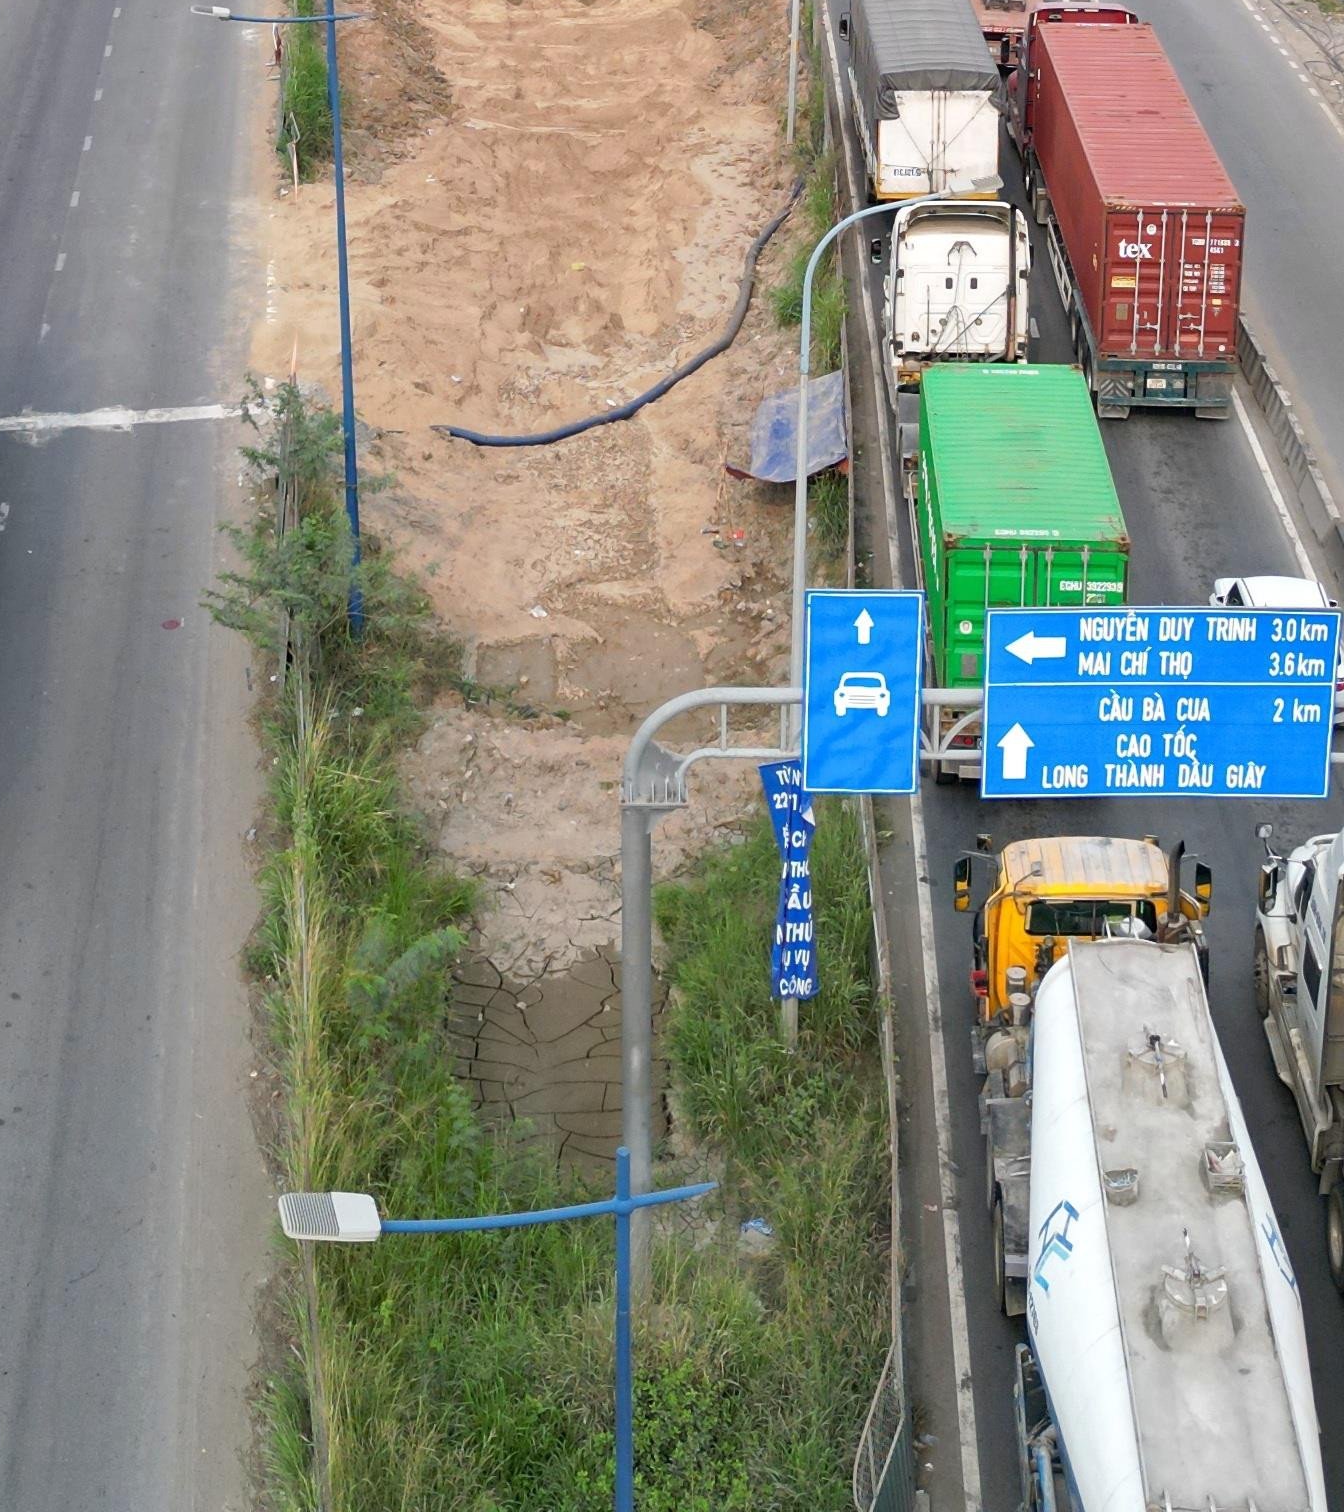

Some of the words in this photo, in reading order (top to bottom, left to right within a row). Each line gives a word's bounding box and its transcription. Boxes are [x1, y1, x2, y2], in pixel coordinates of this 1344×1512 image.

[1118, 238, 1152, 259] tex
[1079, 609, 1148, 642] NGUYỄN
[1159, 618, 1194, 642] DUY
[1207, 618, 1256, 642] TRINH
[1271, 619, 1297, 642] 3.0
[1299, 619, 1328, 642] km
[1079, 652, 1111, 676] MAI
[1120, 646, 1153, 676] CHÍ
[1159, 651, 1193, 680] THỌ
[1268, 652, 1295, 677] 3.6
[1297, 652, 1325, 676] km
[1099, 688, 1135, 722] CẦU
[1142, 691, 1167, 722] BÀ
[1176, 698, 1211, 722] CUA
[1272, 697, 1285, 722] 2
[1292, 698, 1321, 723] km
[1117, 734, 1153, 758] CAO
[1161, 725, 1199, 759] TỐC
[1042, 765, 1088, 790] LONG
[1105, 758, 1165, 789] THÀNH
[1178, 755, 1214, 789] DẦU
